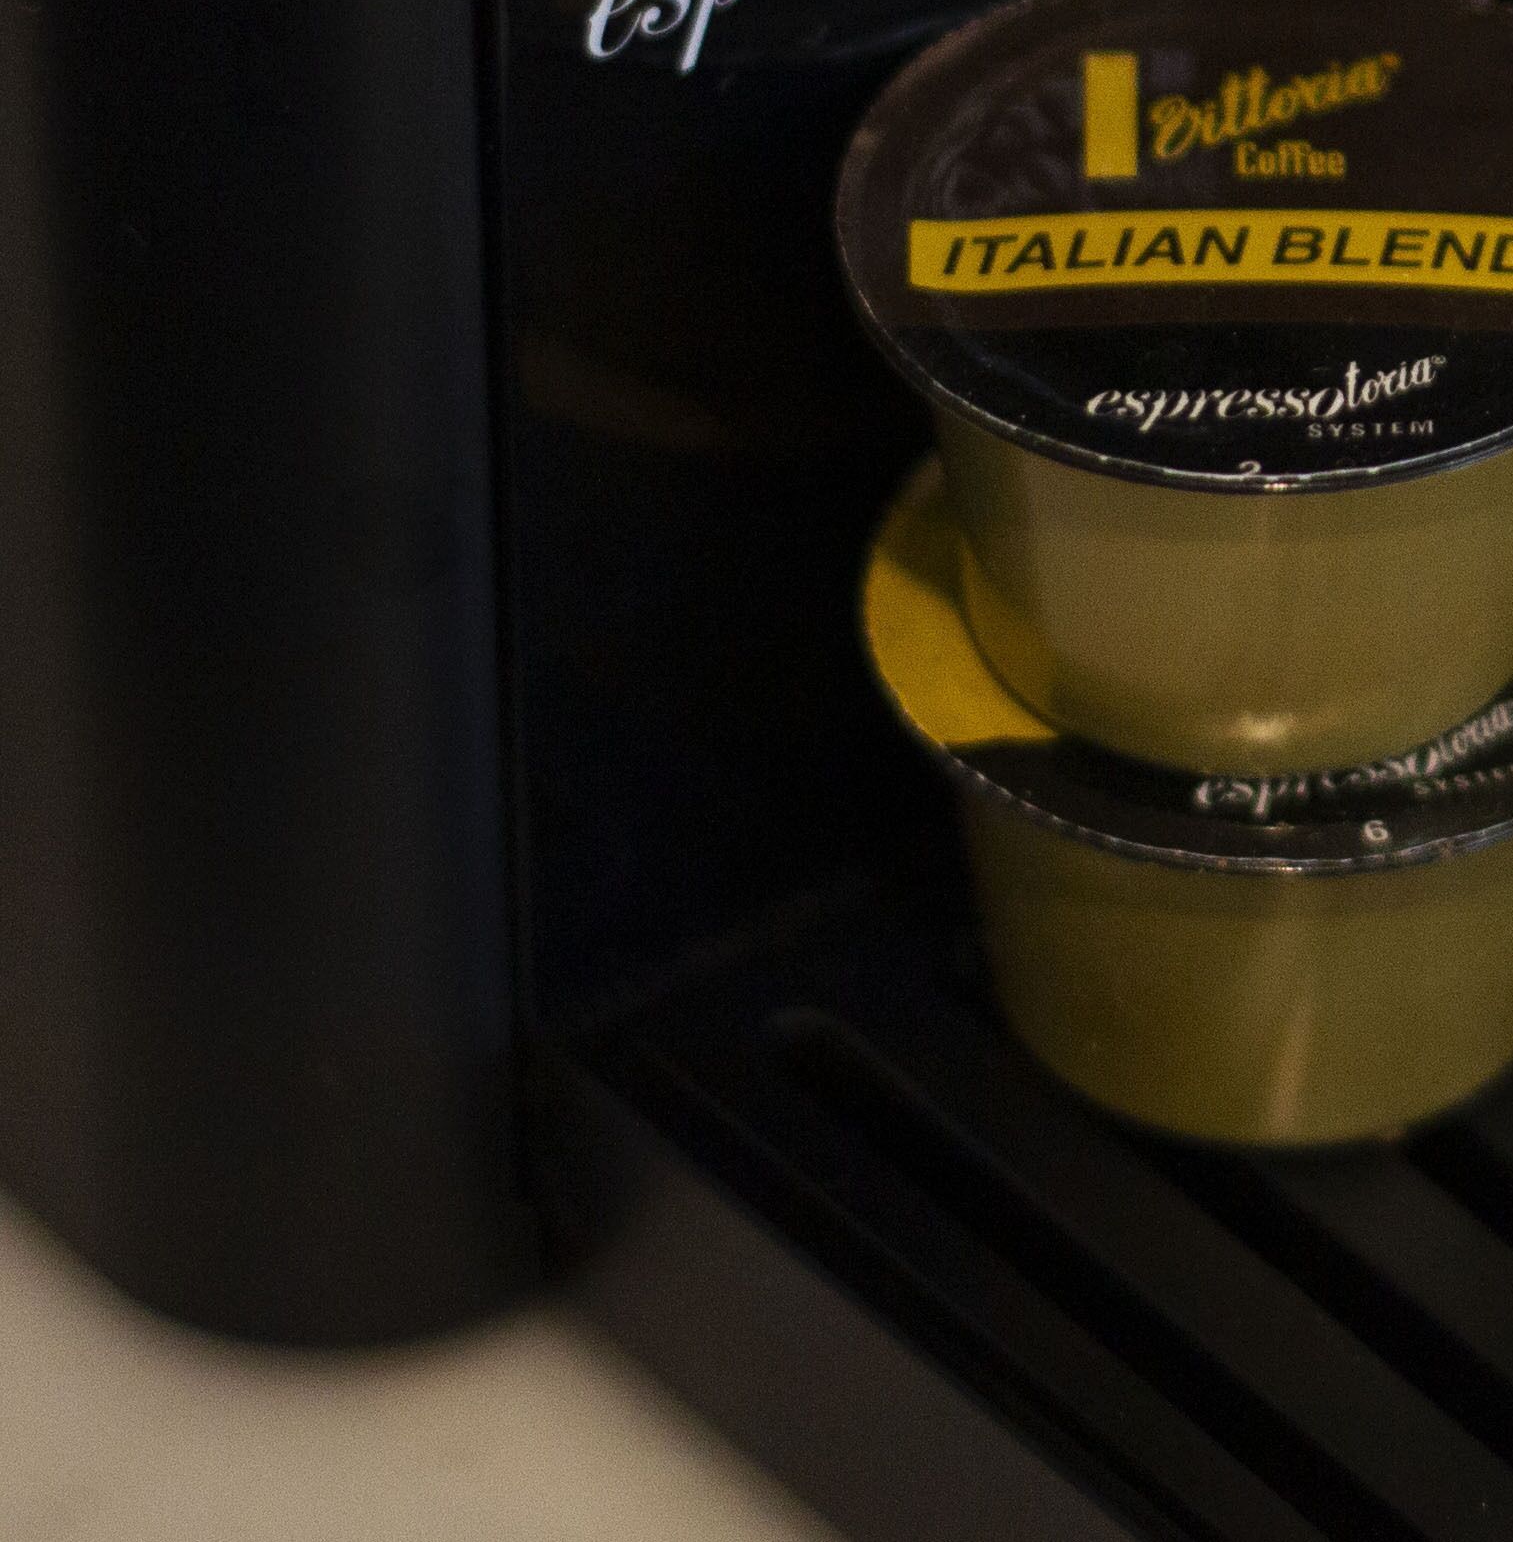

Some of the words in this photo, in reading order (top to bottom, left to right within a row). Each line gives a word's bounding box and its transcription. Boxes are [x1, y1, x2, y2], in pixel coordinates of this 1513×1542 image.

[1234, 139, 1348, 179] Coffee
[943, 225, 1249, 276] ITALIAN
[1085, 357, 1437, 432] espressotoria
[1307, 418, 1435, 439] SYSTEM
[1362, 818, 1390, 844] 6
